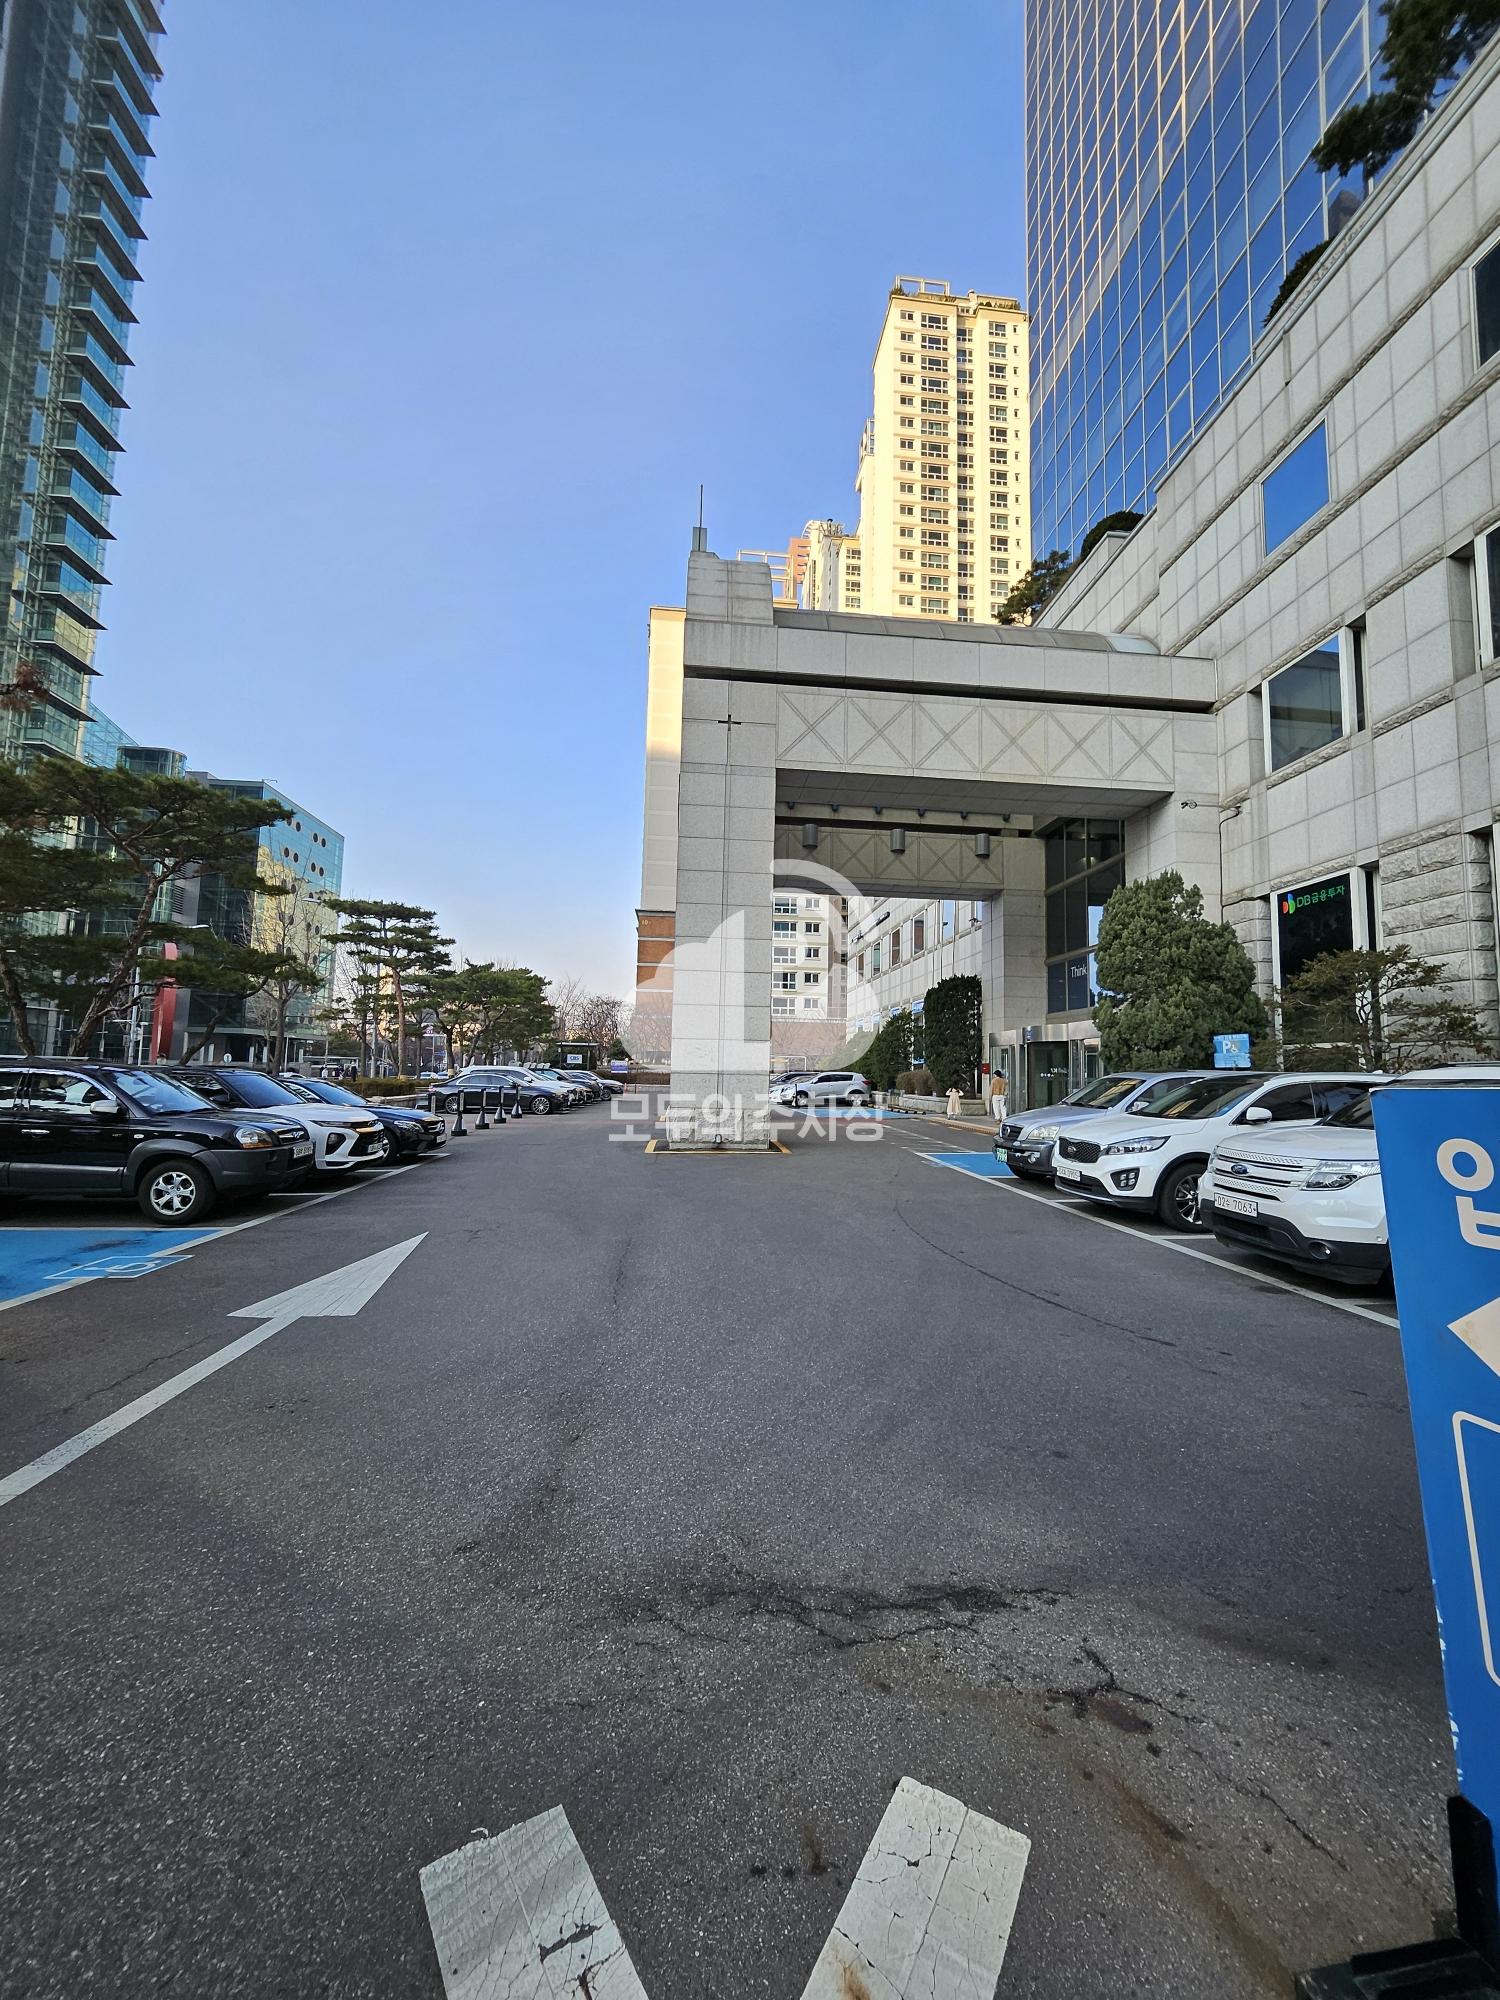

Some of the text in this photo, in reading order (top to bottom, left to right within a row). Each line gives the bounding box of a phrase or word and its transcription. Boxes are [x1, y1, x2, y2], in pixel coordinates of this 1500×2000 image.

[1296, 885, 1345, 908] DB금융투자
[1070, 964, 1088, 979] Think
[1222, 1040, 1231, 1055] P
[1233, 1199, 1253, 1214] 7063
